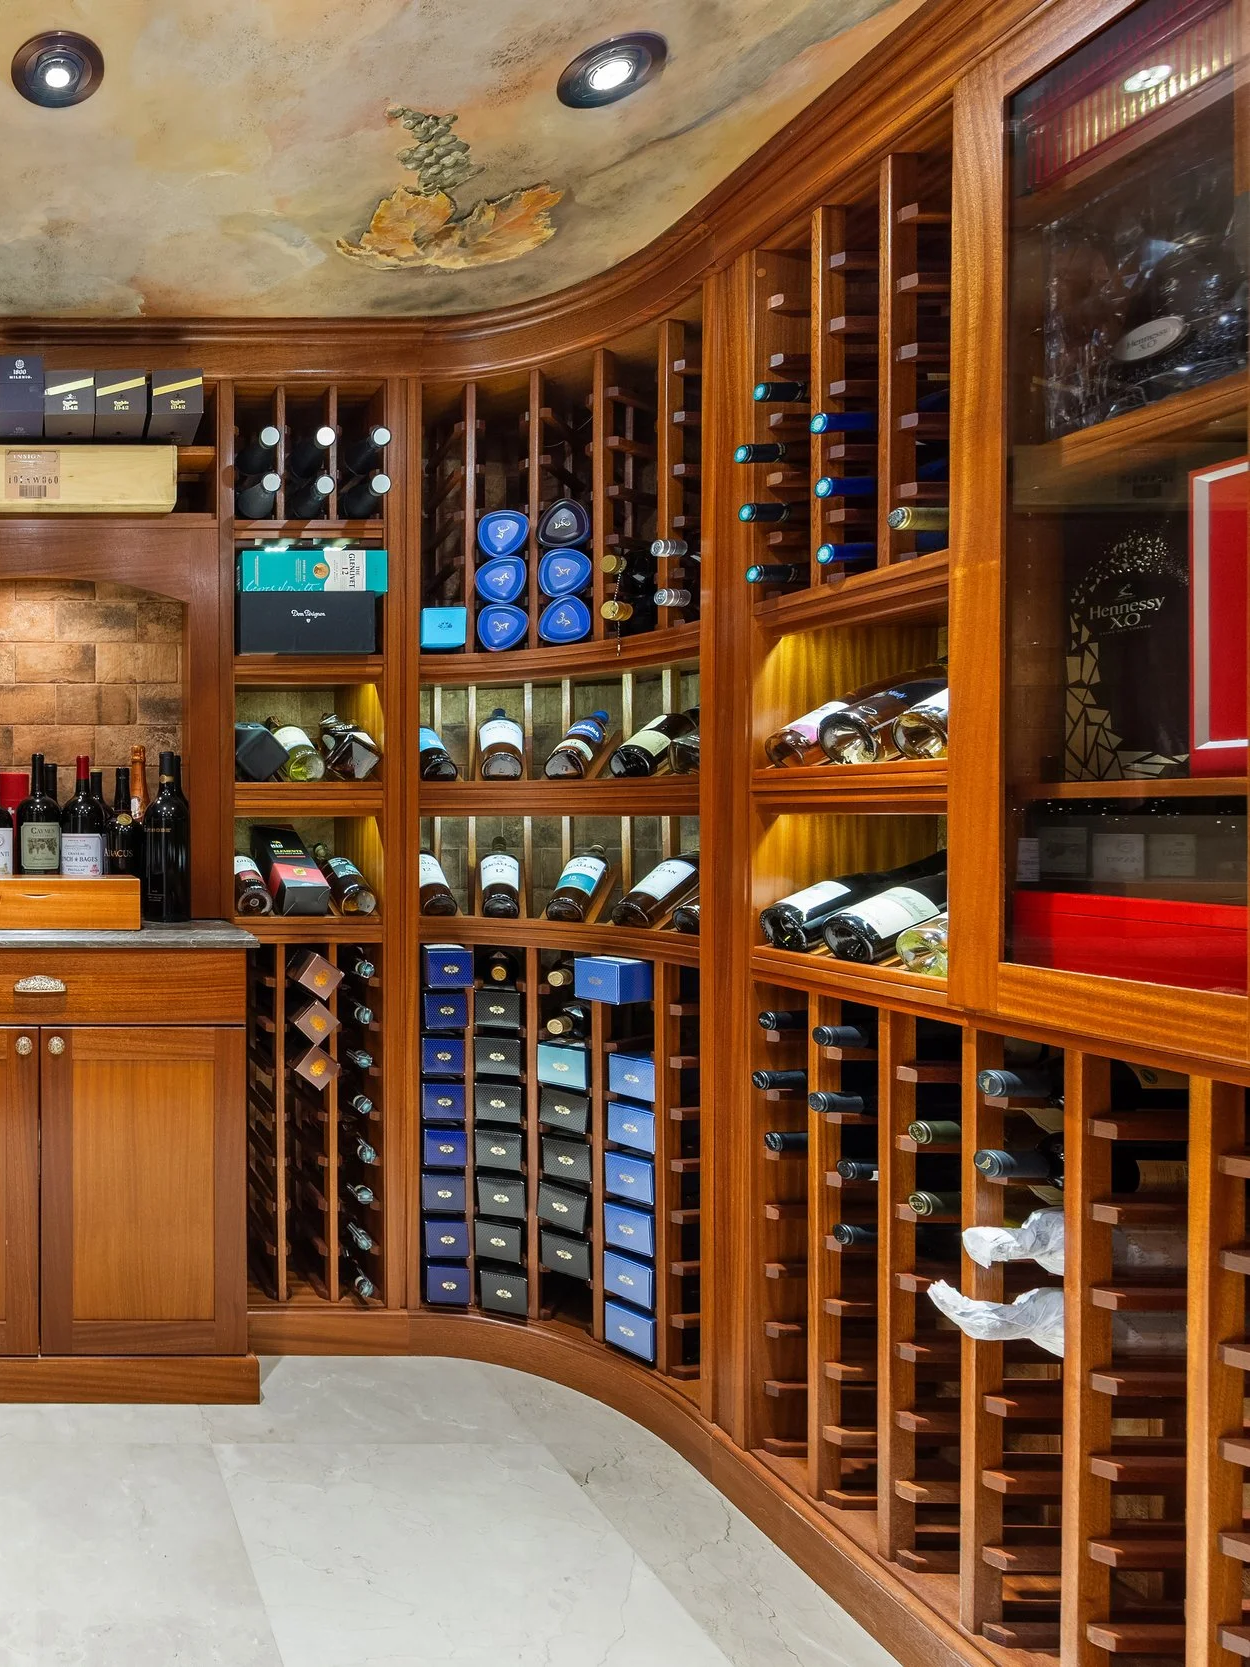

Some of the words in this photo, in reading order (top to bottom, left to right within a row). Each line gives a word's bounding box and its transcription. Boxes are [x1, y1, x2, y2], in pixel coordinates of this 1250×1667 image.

[342, 567, 348, 575] 12
[1090, 597, 1166, 620] Hennessy
[291, 609, 304, 617] Dom
